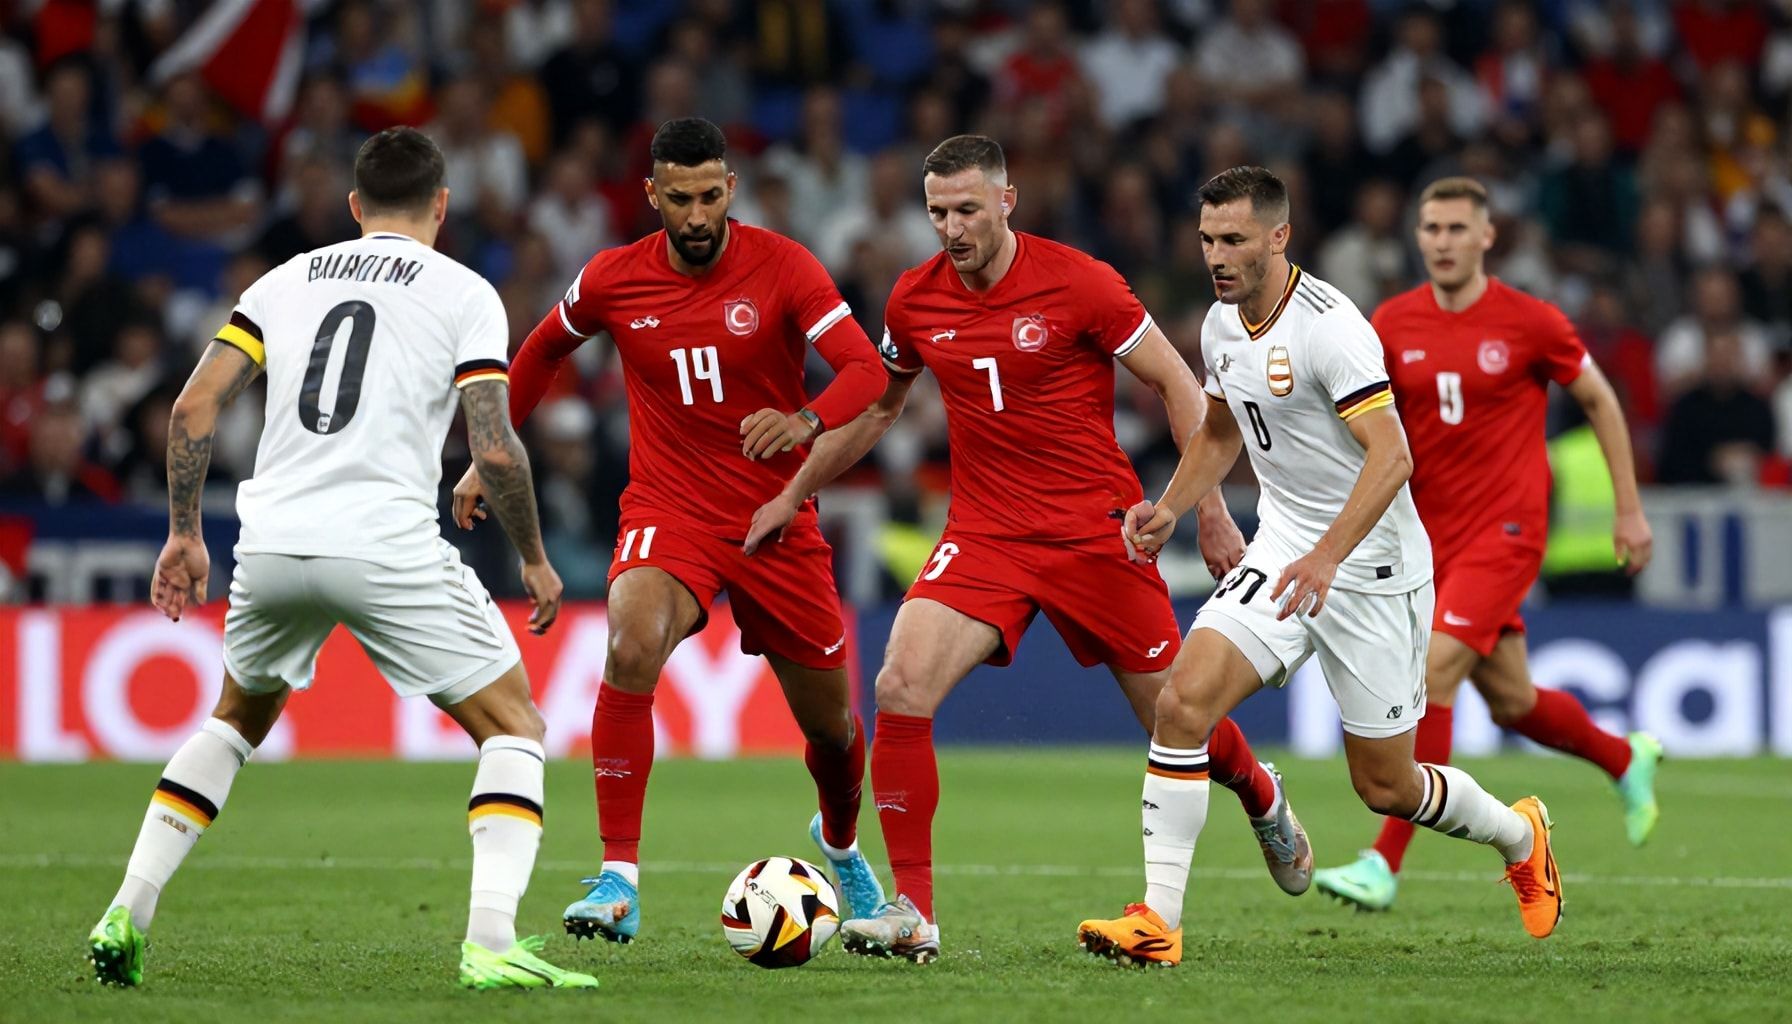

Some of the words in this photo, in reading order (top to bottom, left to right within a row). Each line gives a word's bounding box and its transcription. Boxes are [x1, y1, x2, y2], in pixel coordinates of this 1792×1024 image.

[669, 346, 724, 405] 14
[972, 357, 1004, 412] 7
[620, 526, 657, 562] 11
